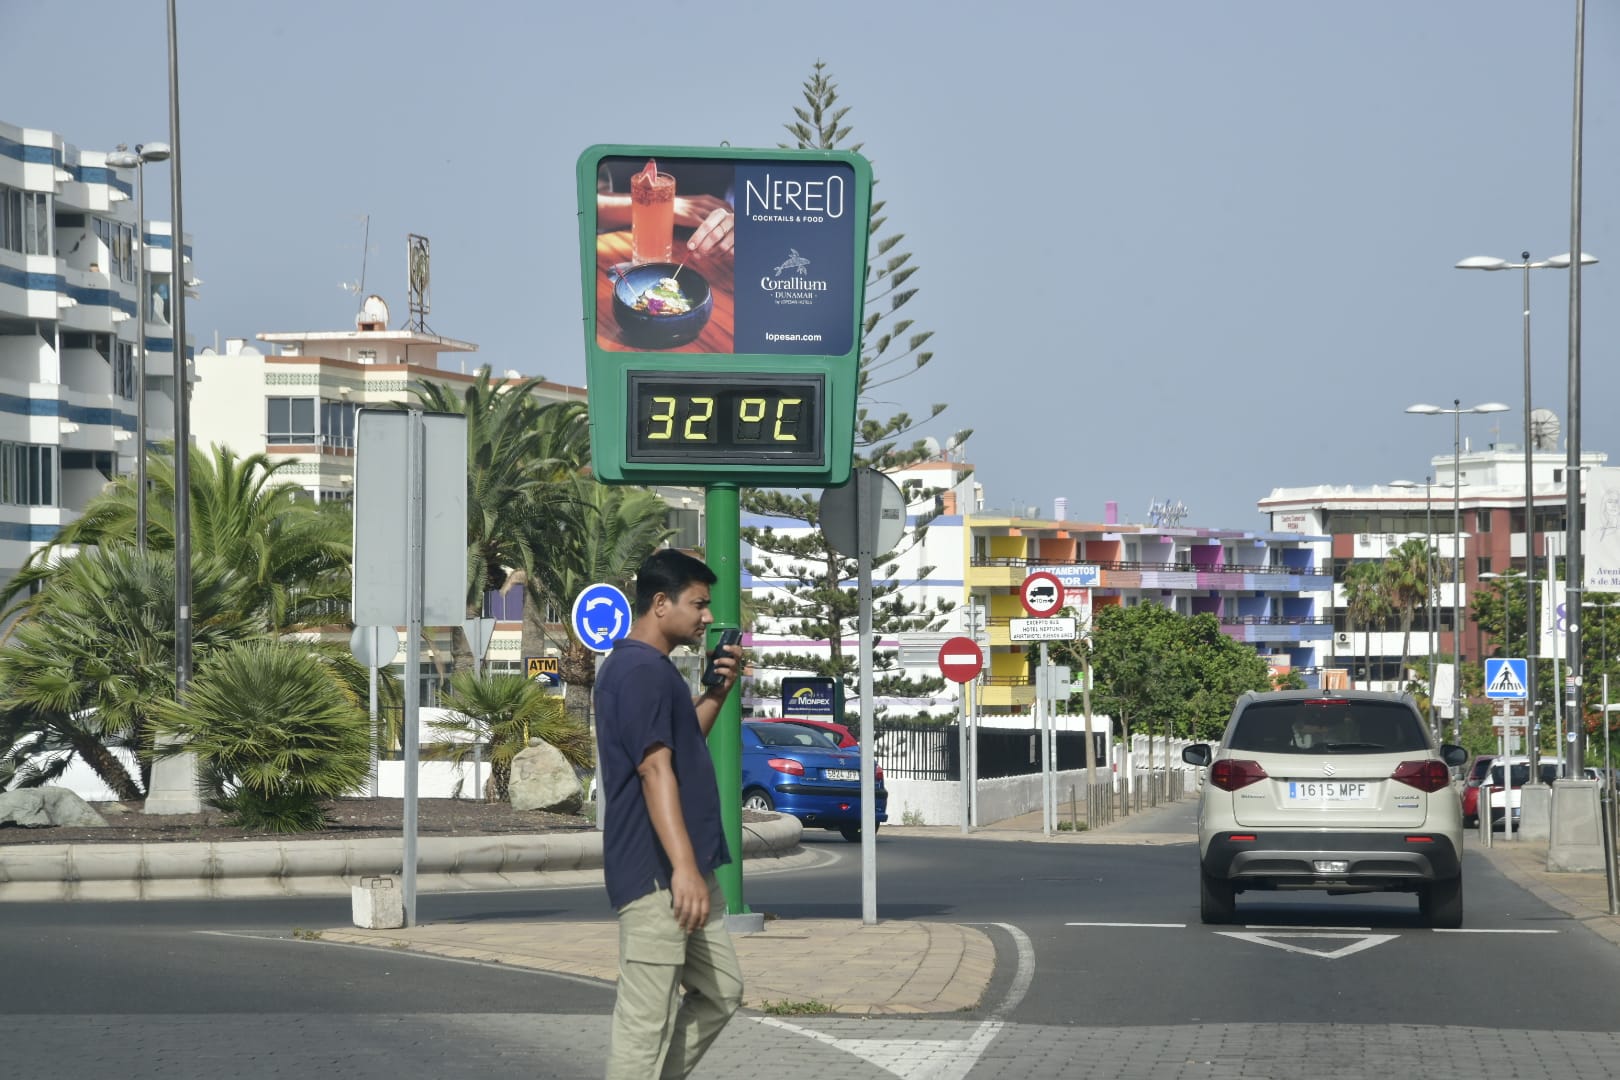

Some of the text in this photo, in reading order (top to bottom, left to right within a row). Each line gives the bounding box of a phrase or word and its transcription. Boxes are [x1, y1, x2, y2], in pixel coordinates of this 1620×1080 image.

[746, 173, 844, 218] NEREO
[760, 276, 828, 291] Corallium
[765, 331, 822, 342] lopesan.com
[647, 396, 714, 439] 32
[529, 660, 557, 671] ATM
[1300, 784, 1366, 797] 1615 MPF
